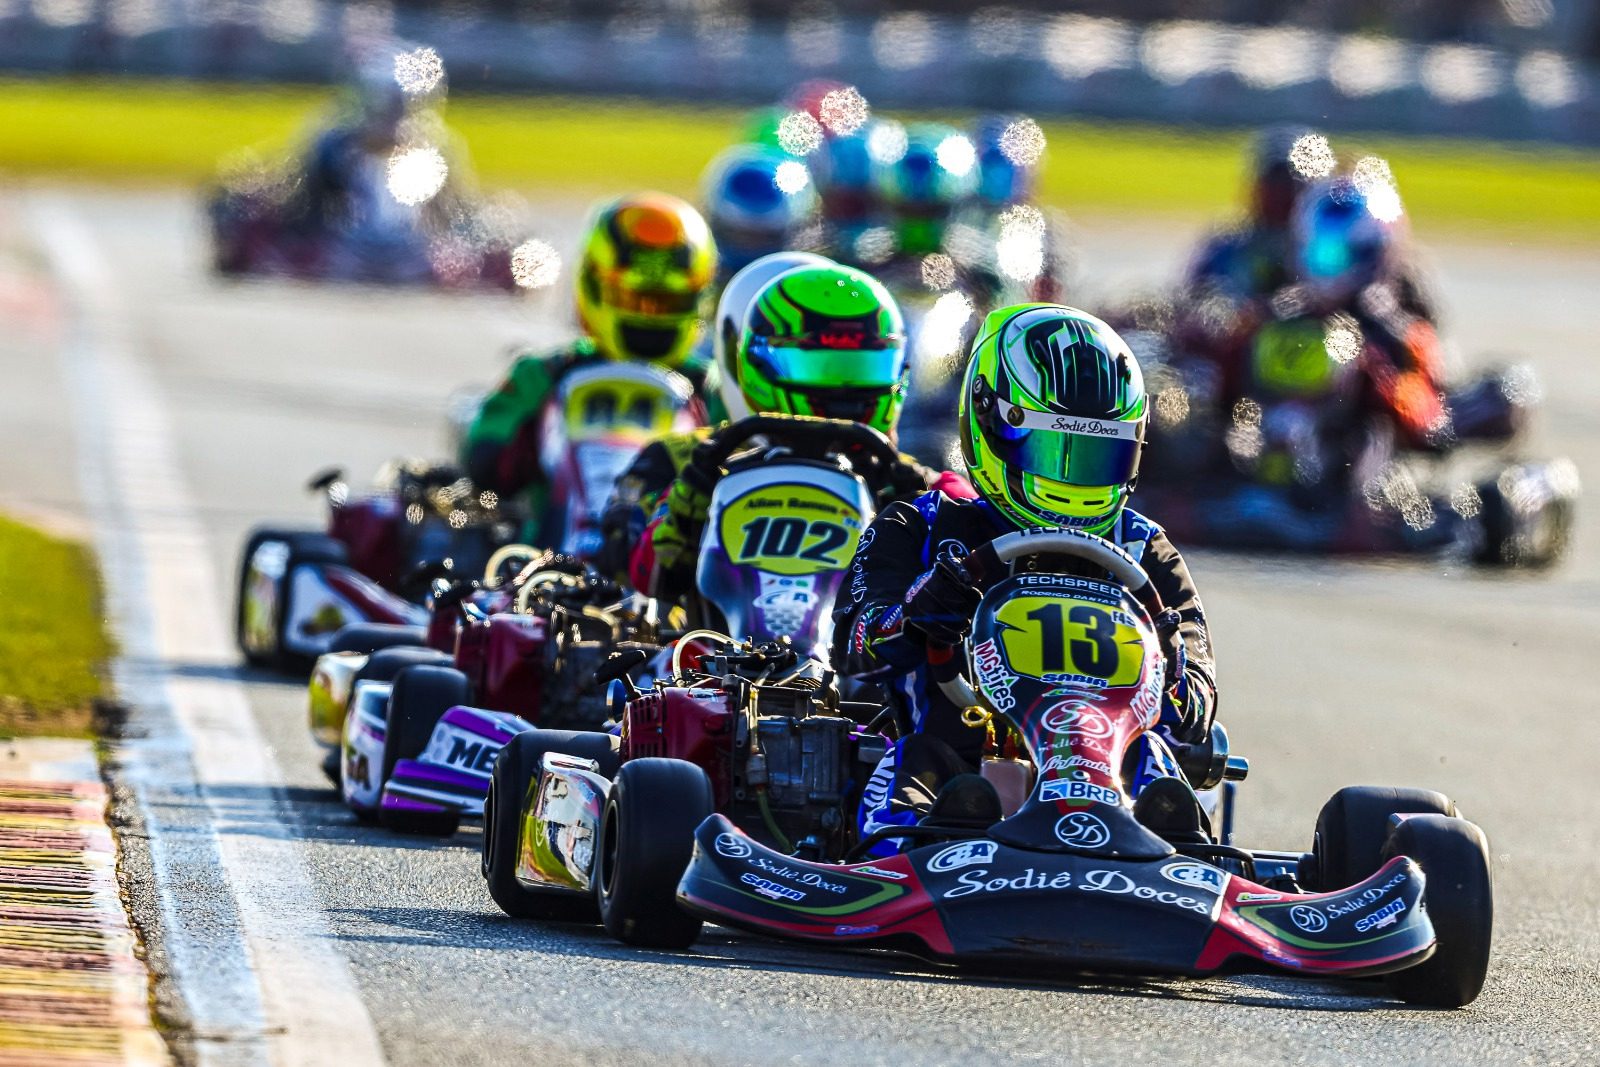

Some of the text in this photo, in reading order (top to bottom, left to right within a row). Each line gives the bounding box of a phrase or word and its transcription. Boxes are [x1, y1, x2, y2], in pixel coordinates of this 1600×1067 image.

[1087, 420, 1119, 436] Doces
[740, 517, 850, 565] 102
[1017, 576, 1123, 598] TECHSPEED
[1021, 590, 1071, 598] RODRIGO
[1026, 603, 1119, 679] 13
[975, 640, 1014, 710] MGtires
[1070, 782, 1118, 804] BRB
[940, 842, 989, 868] CBA
[798, 873, 847, 894] Doces
[1172, 867, 1220, 886] CBA
[943, 867, 1209, 914] Sodiê Doces
